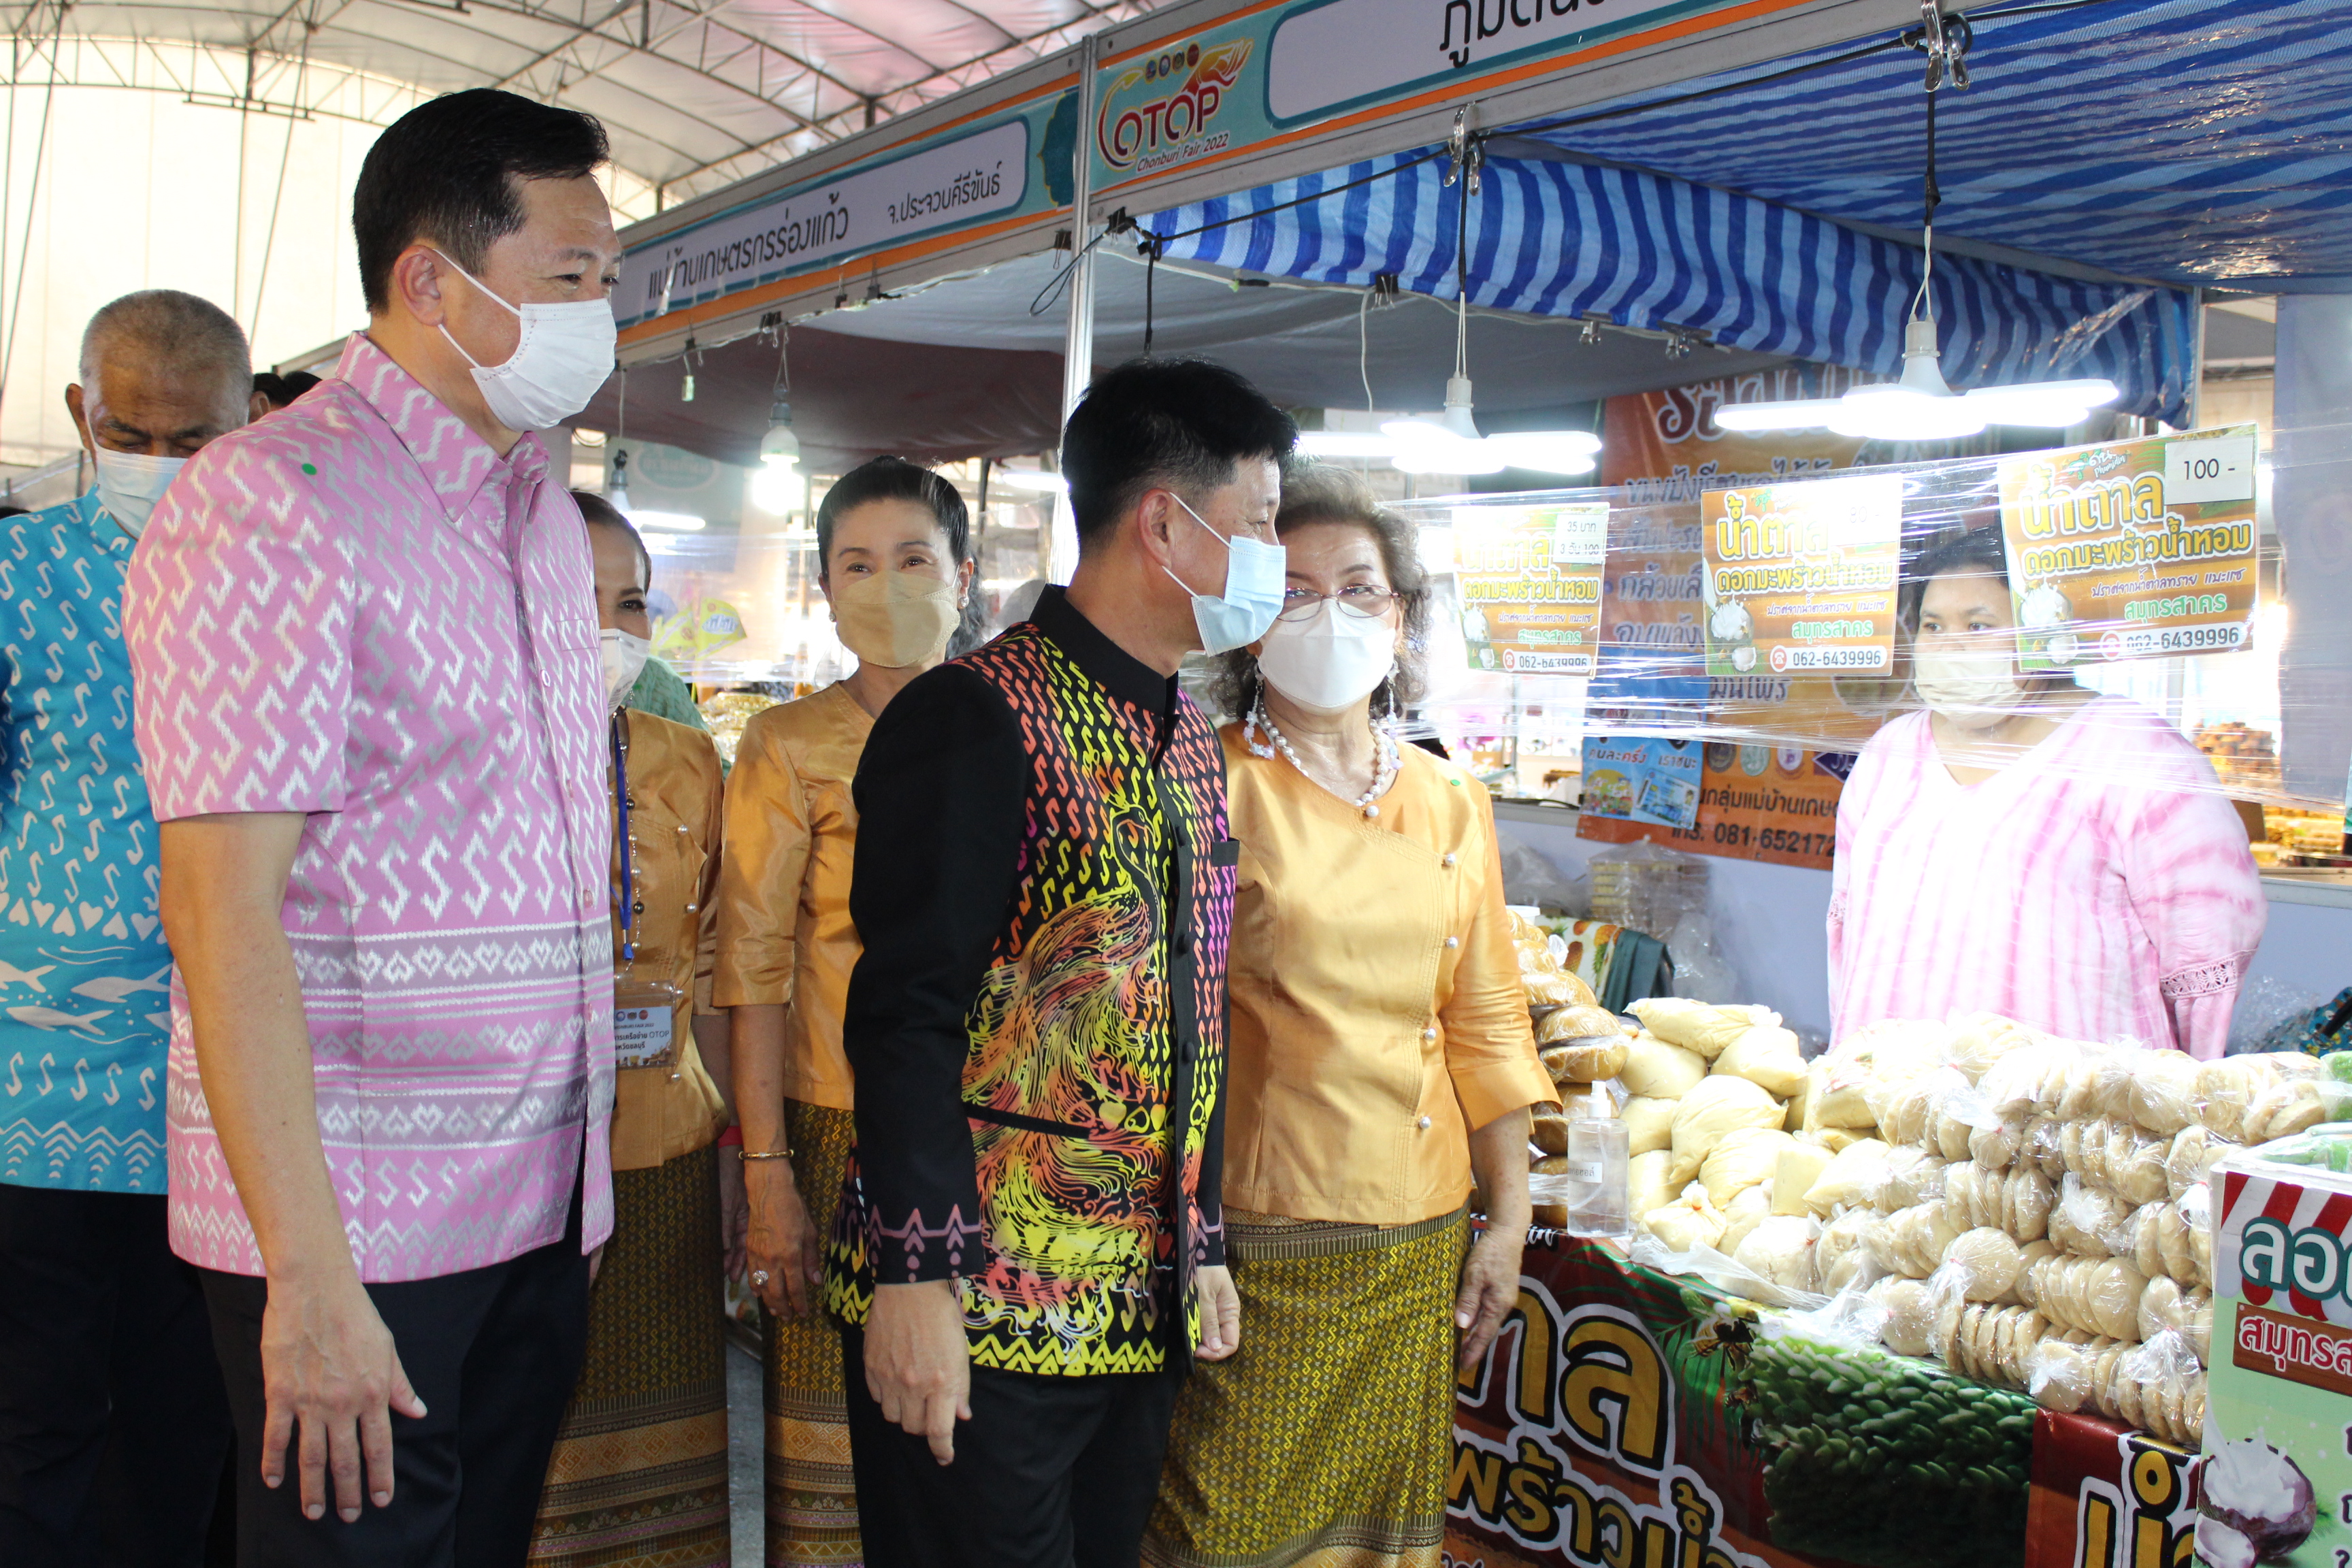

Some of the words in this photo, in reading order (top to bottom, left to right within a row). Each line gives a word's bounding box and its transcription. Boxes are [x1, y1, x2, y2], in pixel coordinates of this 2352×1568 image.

[1113, 84, 1220, 157] OTOP
[1137, 146, 1181, 172] Chonburi
[1181, 141, 1201, 159] Fair
[1203, 133, 1229, 153] 2022
[887, 160, 1002, 225] จ.ประจวบคีรีขันธ์
[2183, 458, 2221, 480] 100
[2021, 463, 2166, 538] น้ำตาล
[1567, 521, 1578, 533] 35
[1580, 521, 1597, 533] บาท
[1718, 494, 1830, 558] น้ำตาล
[1584, 544, 1600, 556] 100
[2023, 515, 2253, 576] ดอกมะพร้าวน้ำหอม
[1463, 568, 1599, 600] ดอกมะพร้าวน้ำหอม
[1716, 550, 1894, 593] ดอกมะพร้าวน้ำหอม
[2125, 593, 2227, 624] สมุทรสาคร
[1518, 628, 1583, 650] สมุทรสาคร
[1792, 620, 1874, 644] สมุทรสาคร
[2126, 626, 2240, 652] 062-6439996
[1518, 655, 1588, 670] 062-6439996
[1792, 649, 1882, 667] 062-6439996
[1659, 755, 1698, 770] เราชนะ
[649, 1030, 670, 1039] OTOP
[2242, 1222, 2352, 1301] ลอ
